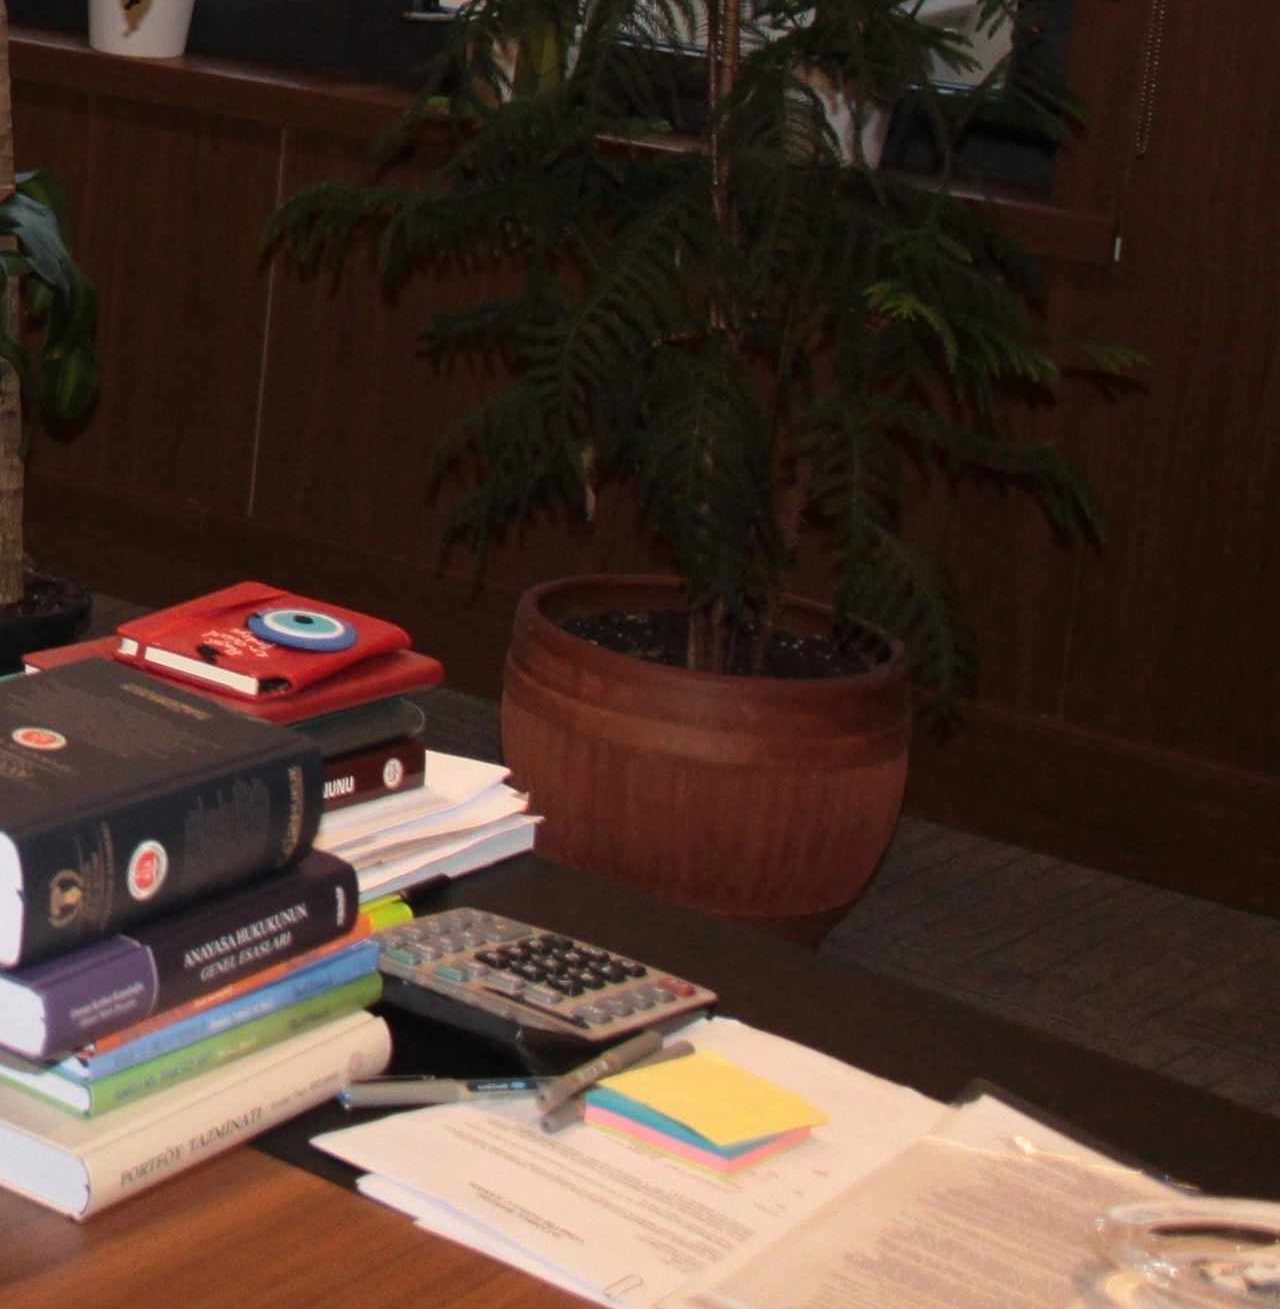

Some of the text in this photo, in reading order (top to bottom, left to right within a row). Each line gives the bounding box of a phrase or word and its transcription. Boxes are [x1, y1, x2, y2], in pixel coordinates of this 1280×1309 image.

[322, 774, 356, 800] UNU
[182, 901, 309, 969] ANAYASA HUKUKUNUN
[199, 929, 293, 983] GENEL ESASLARI
[119, 1104, 265, 1187] PORTFÖY TAZMİNATI
